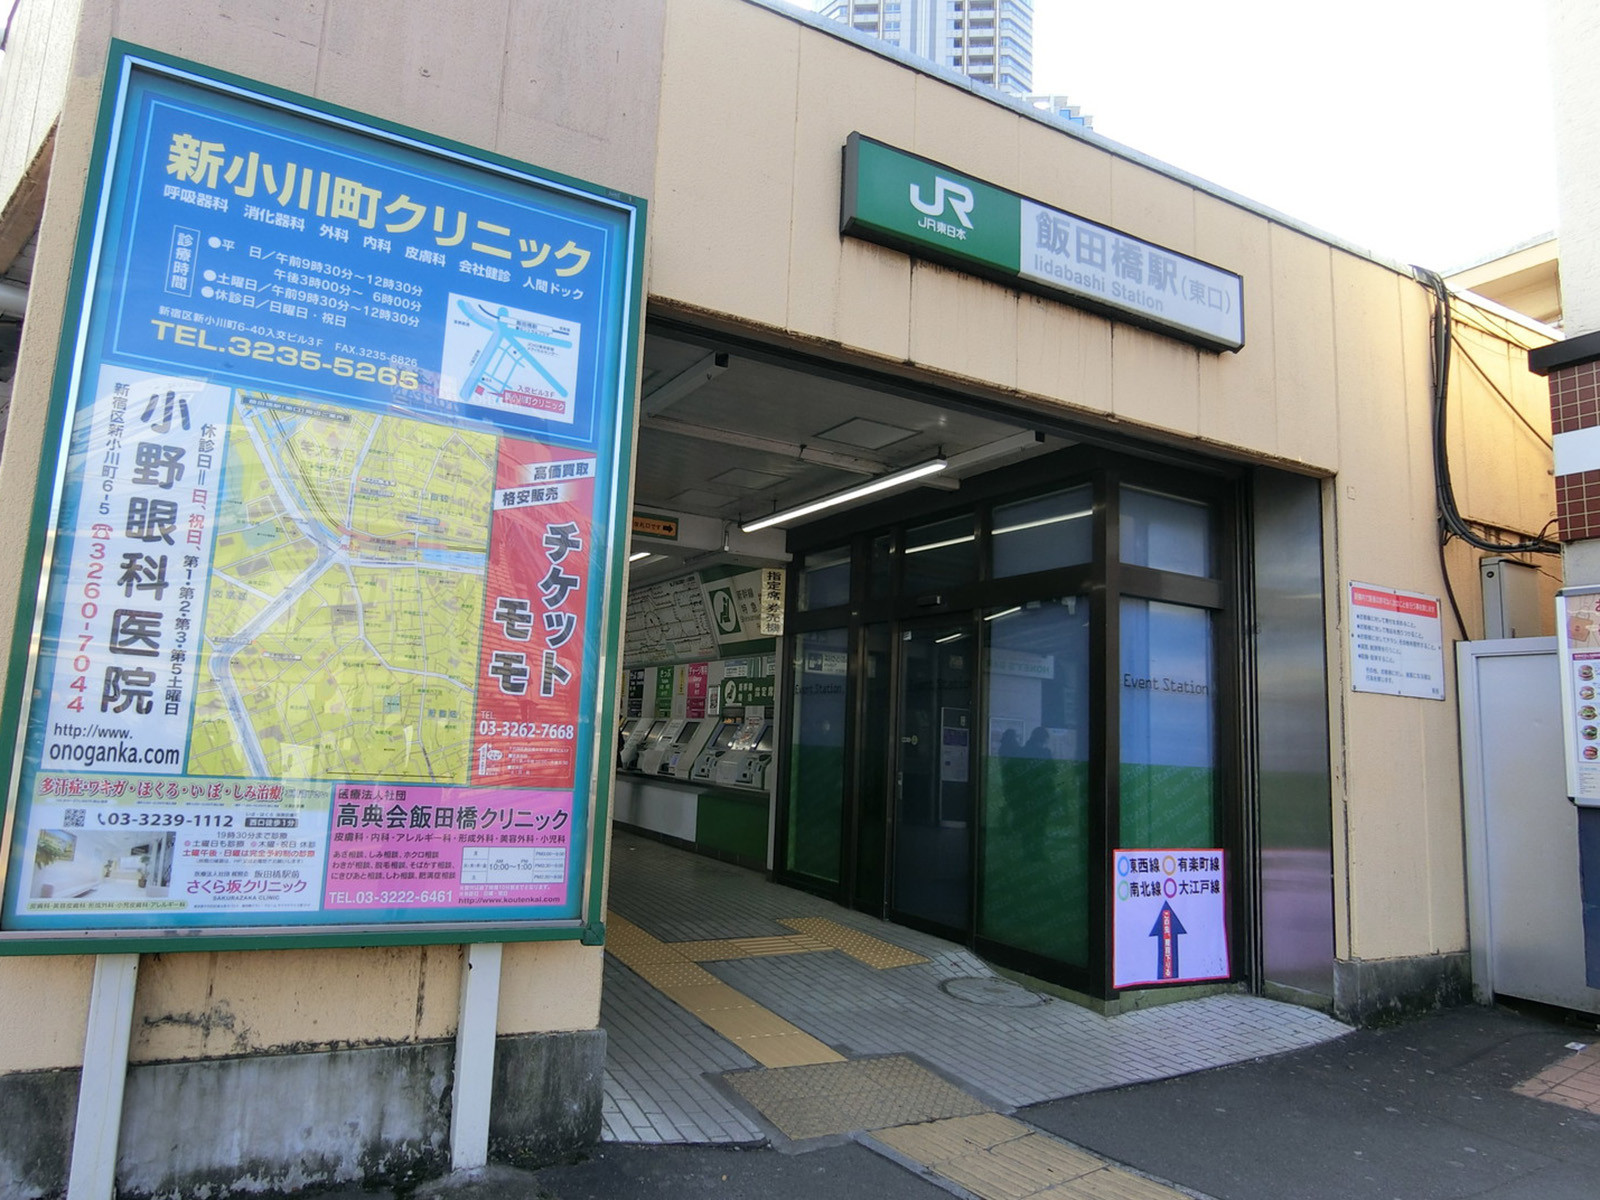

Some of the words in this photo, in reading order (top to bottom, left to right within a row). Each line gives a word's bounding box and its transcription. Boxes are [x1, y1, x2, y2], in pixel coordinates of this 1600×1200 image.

[166, 133, 591, 277] 新小川町クリニック
[909, 176, 974, 230] JR
[917, 216, 967, 241] JR東日本
[163, 184, 229, 213] 呼吸器科
[243, 204, 306, 232] 消化器科
[319, 223, 349, 243] 外科
[363, 236, 392, 254] 内科
[404, 246, 446, 267] 皮膚科
[458, 260, 511, 283] 会社健診
[522, 276, 584, 301] 人間ドック
[170, 233, 194, 291] 診療時間
[1034, 254, 1106, 292] Iidabashi
[1111, 280, 1164, 312] Station
[150, 319, 419, 390] TEL.3235-5265
[334, 342, 418, 367] FAX.3235-6826
[533, 462, 590, 481] 高価買取
[502, 487, 559, 507] 格安販売
[100, 389, 191, 716] 小野眼科医院
[537, 521, 582, 698] チケット
[765, 571, 782, 633] 指定席券売機
[489, 597, 534, 696] モモ
[815, 683, 842, 694] Station
[1124, 673, 1159, 691] Event
[1163, 677, 1209, 695] Station
[54, 722, 134, 740] http://www.
[479, 720, 574, 739] 03-3262-7668
[49, 741, 180, 767] onoganka.com
[338, 788, 407, 801] 医療法人社団
[108, 812, 234, 828] 03-3239-1112
[336, 803, 569, 832] 高典会飯田橋クリニック
[253, 869, 300, 879] 飯田橋駅前
[1129, 857, 1160, 873] 東西線
[1177, 856, 1220, 873] 有楽町線
[187, 879, 307, 895] さくら坂クリニック
[328, 889, 453, 904] TEL.03-3222-6461
[1129, 881, 1162, 898] 南北線
[1178, 879, 1220, 896] 大江戸線
